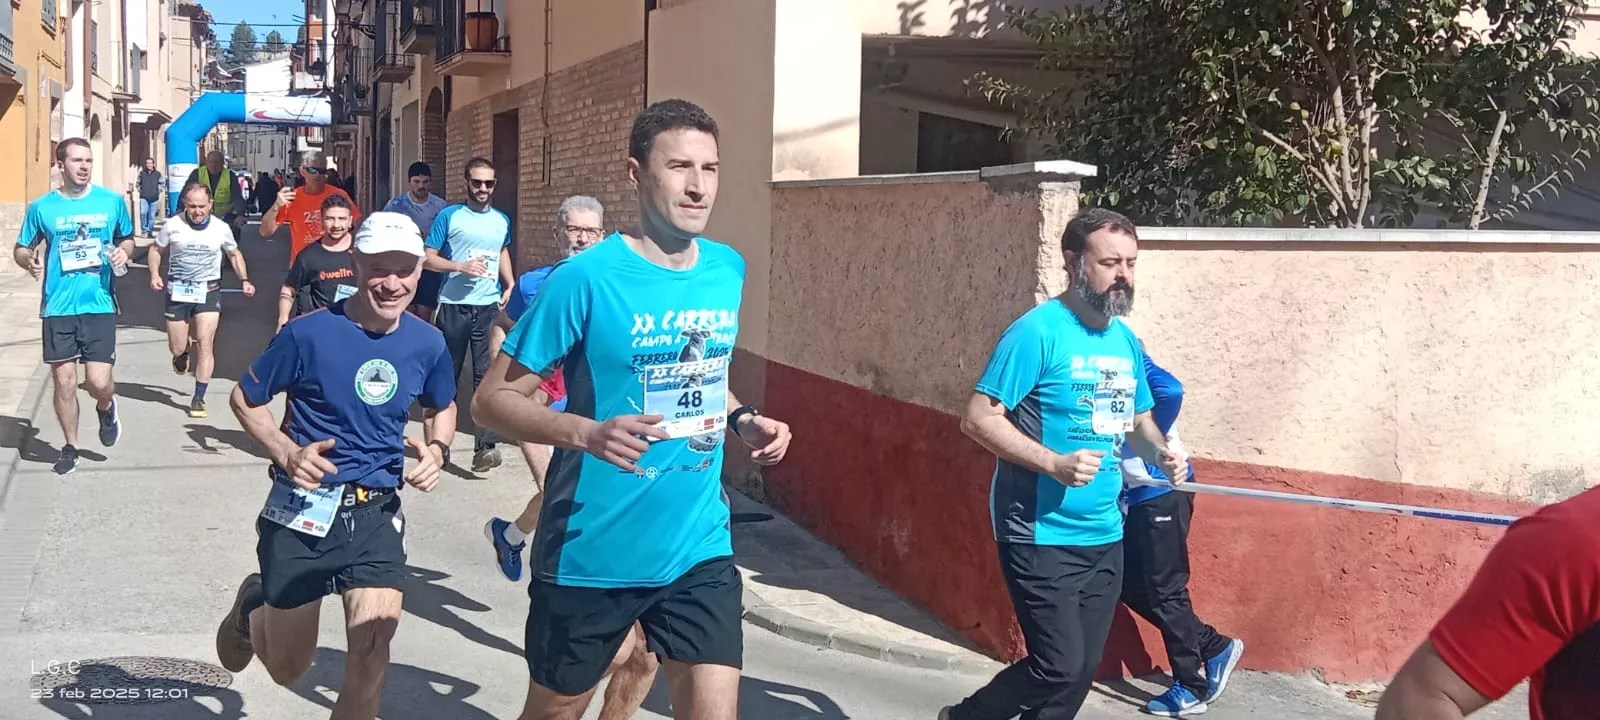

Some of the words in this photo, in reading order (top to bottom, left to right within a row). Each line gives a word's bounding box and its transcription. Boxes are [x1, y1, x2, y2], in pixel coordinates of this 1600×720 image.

[75, 251, 88, 259] 53
[630, 312, 656, 335] XX
[631, 334, 673, 348] CAMPO
[631, 351, 679, 365] FEBRERO
[677, 390, 703, 409] 48
[1110, 400, 1126, 413] 82
[675, 408, 705, 419] CARLOS
[287, 491, 308, 510] 11
